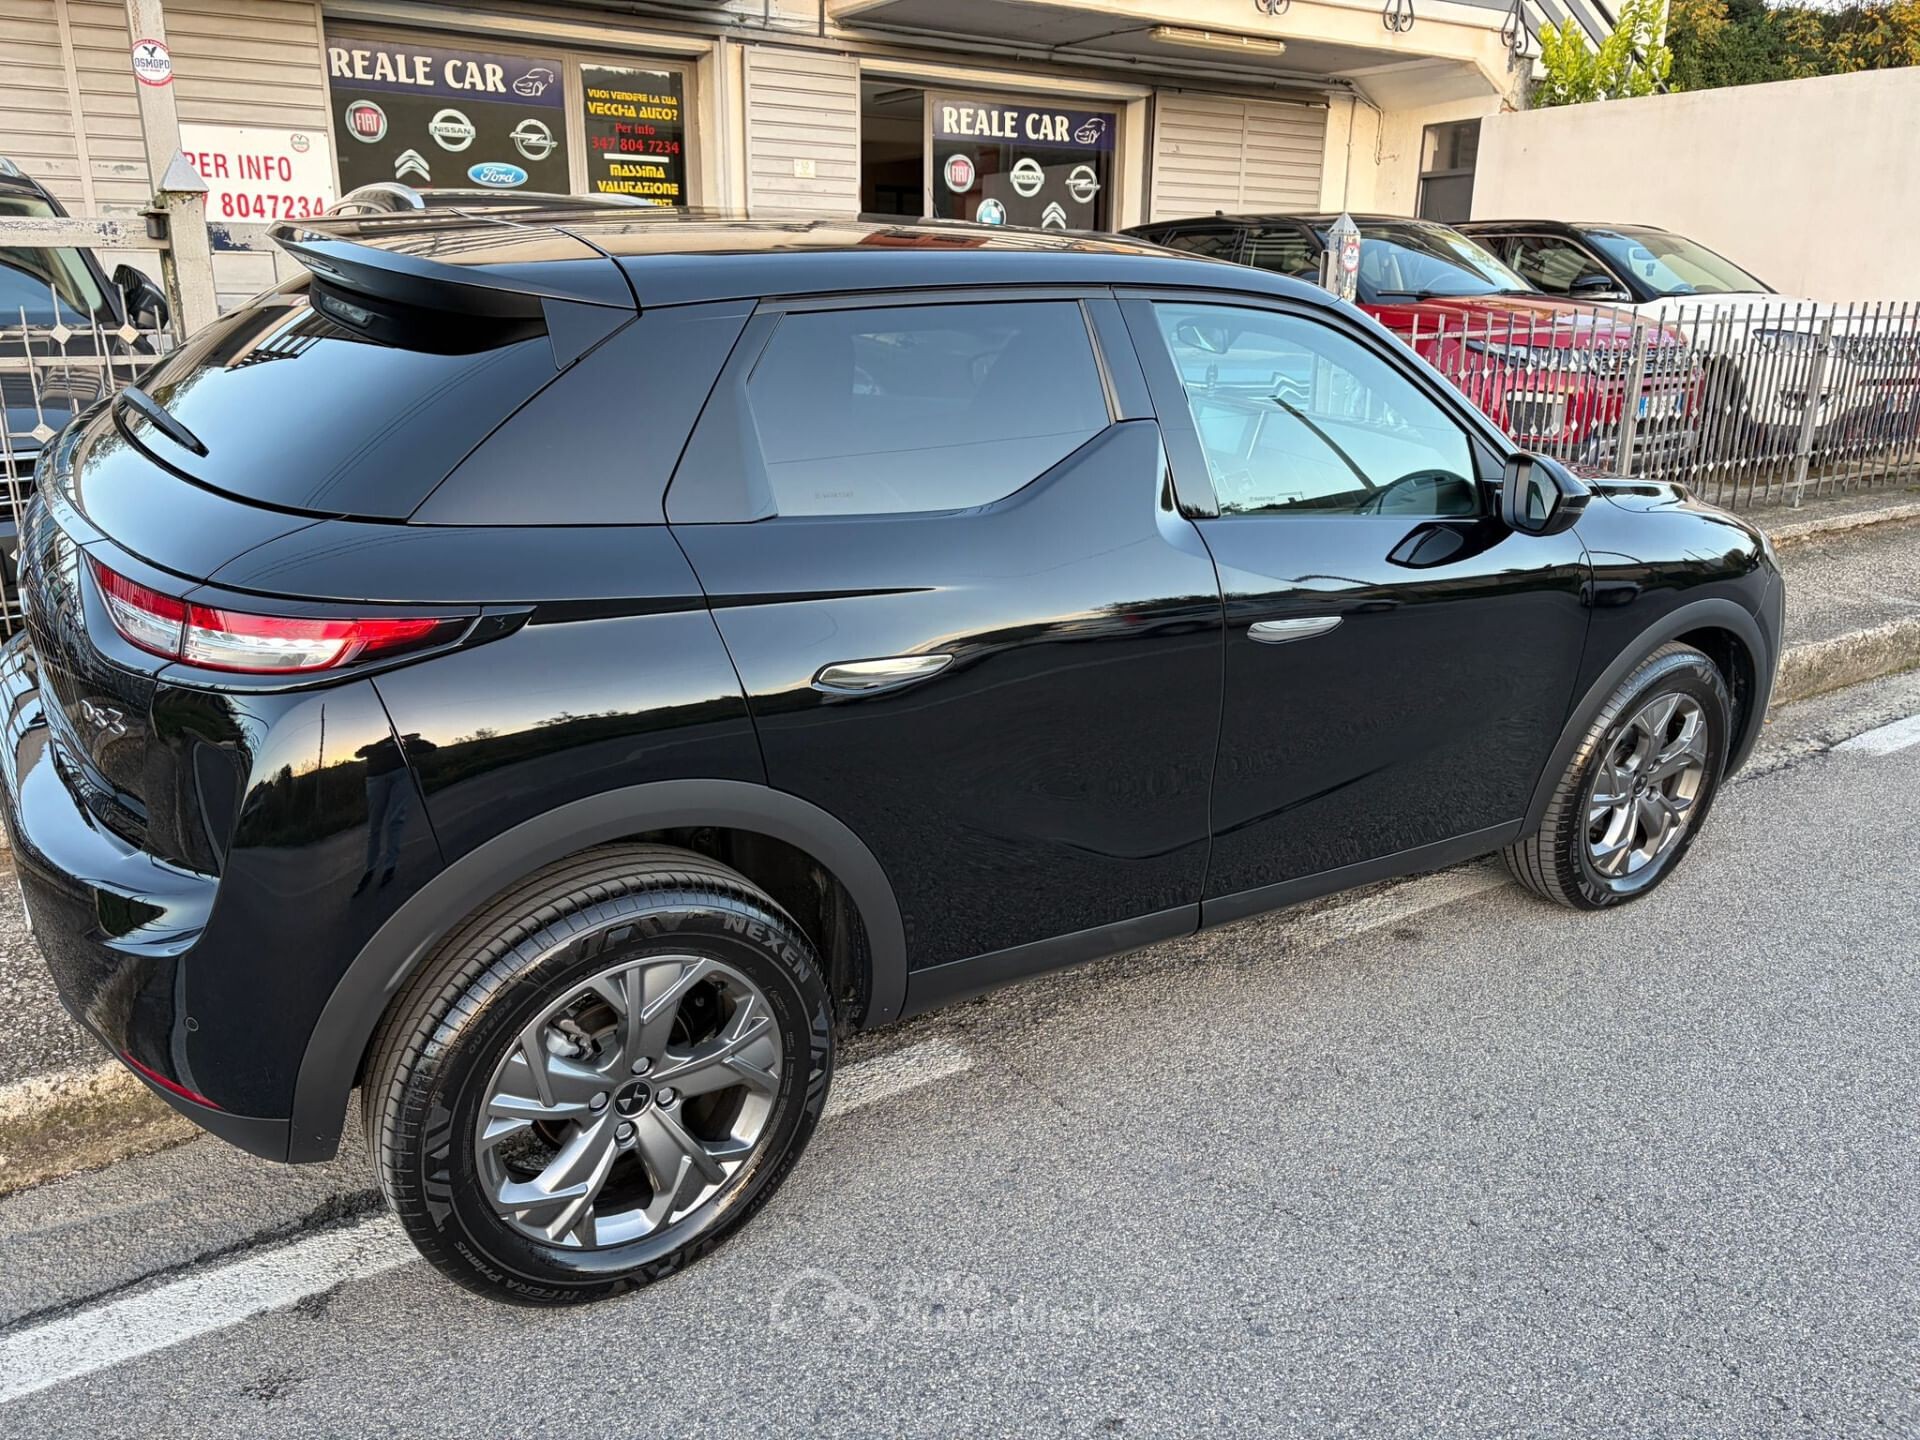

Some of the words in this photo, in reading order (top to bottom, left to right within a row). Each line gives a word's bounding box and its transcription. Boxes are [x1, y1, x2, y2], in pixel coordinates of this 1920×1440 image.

[328, 47, 434, 86] REALE
[444, 59, 506, 93] CAR
[611, 90, 648, 103] VENDERE
[648, 95, 660, 104] LA
[355, 112, 380, 132] FIAT
[639, 106, 678, 121] AUTO?
[433, 126, 473, 136] NISSAN
[615, 123, 632, 134] Per
[942, 106, 1018, 139] REALE
[1025, 113, 1070, 142] CAR
[592, 136, 616, 151] 347
[619, 139, 644, 153] 804
[648, 140, 680, 155] 7234
[238, 155, 292, 182] INFO
[480, 167, 516, 184] Ford
[951, 165, 969, 182] FIAT
[1013, 173, 1042, 182] NISSAN
[221, 192, 324, 219] 8047234
[723, 914, 812, 984] NEXEN
[453, 1240, 504, 1283] Primus
